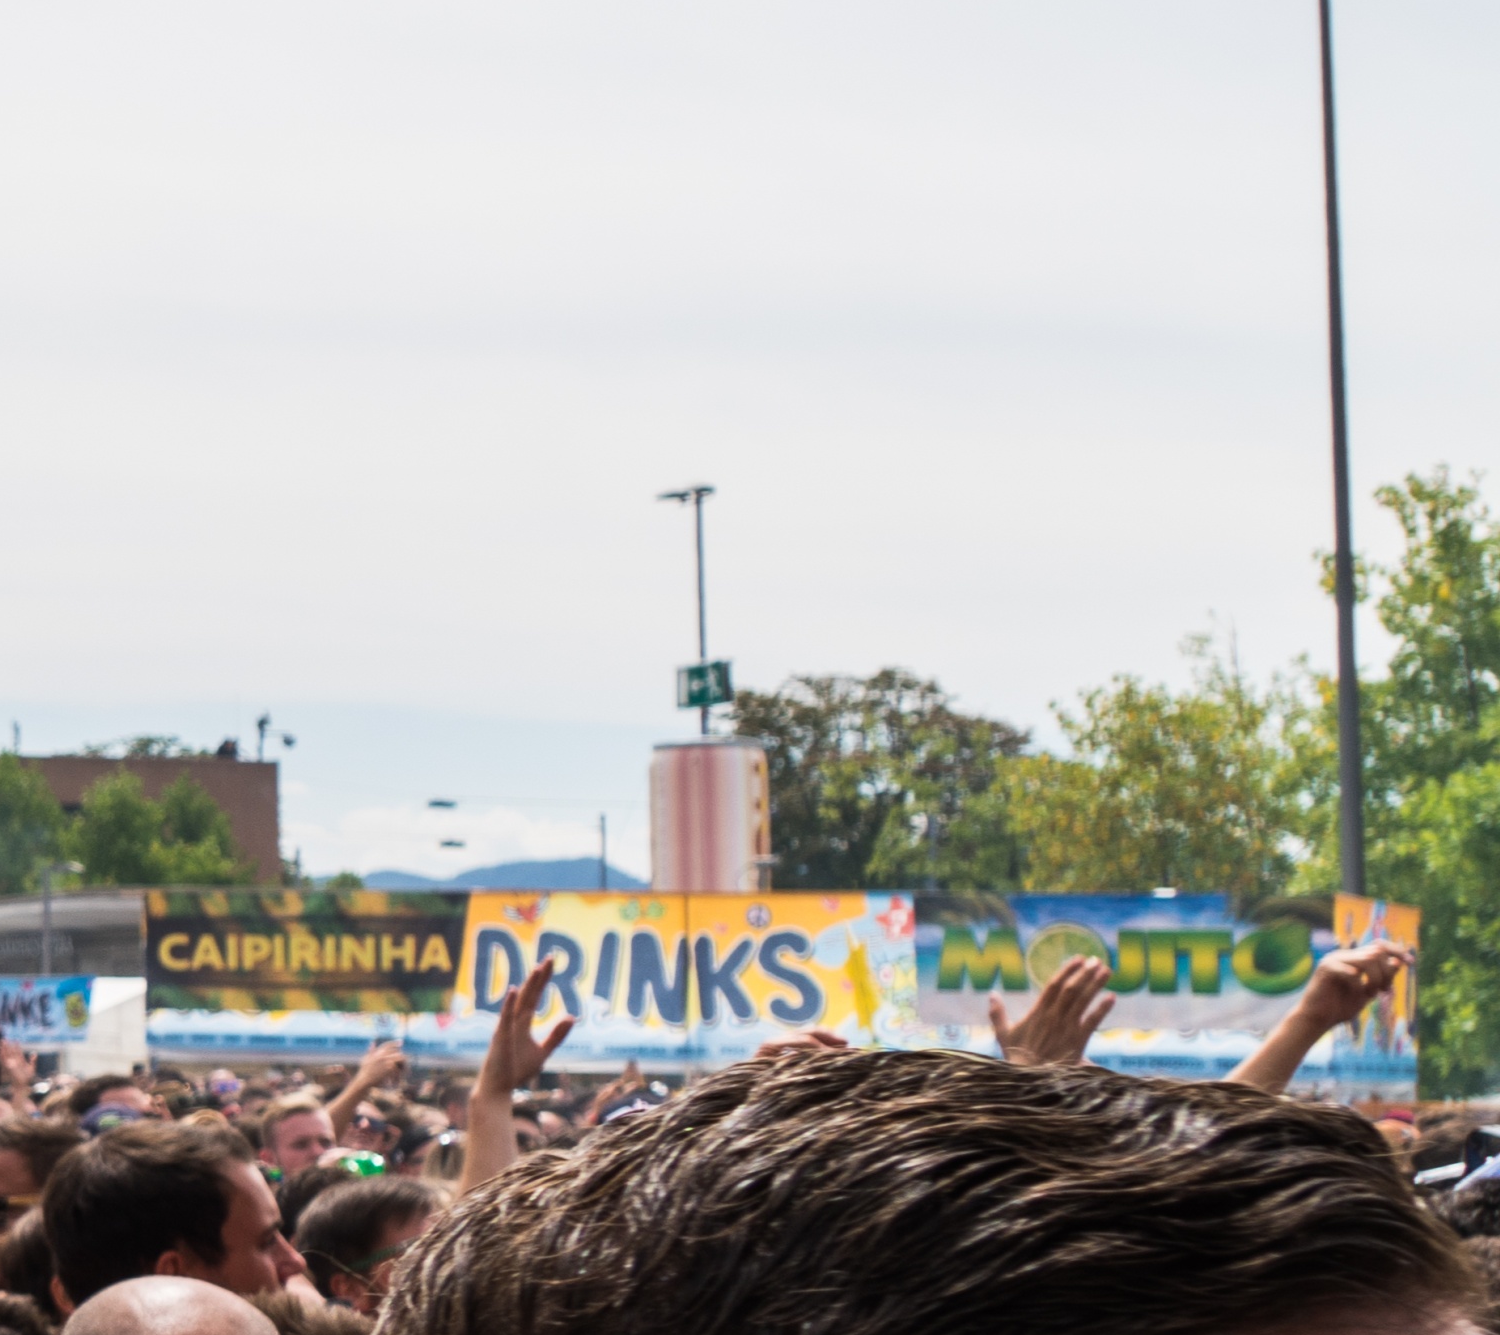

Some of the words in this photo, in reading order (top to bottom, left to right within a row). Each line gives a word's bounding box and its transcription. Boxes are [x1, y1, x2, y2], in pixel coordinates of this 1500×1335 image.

[157, 931, 452, 973] CAIPIRINHA
[473, 926, 823, 1023] DRINKS
[936, 922, 1314, 996] MOJITO
